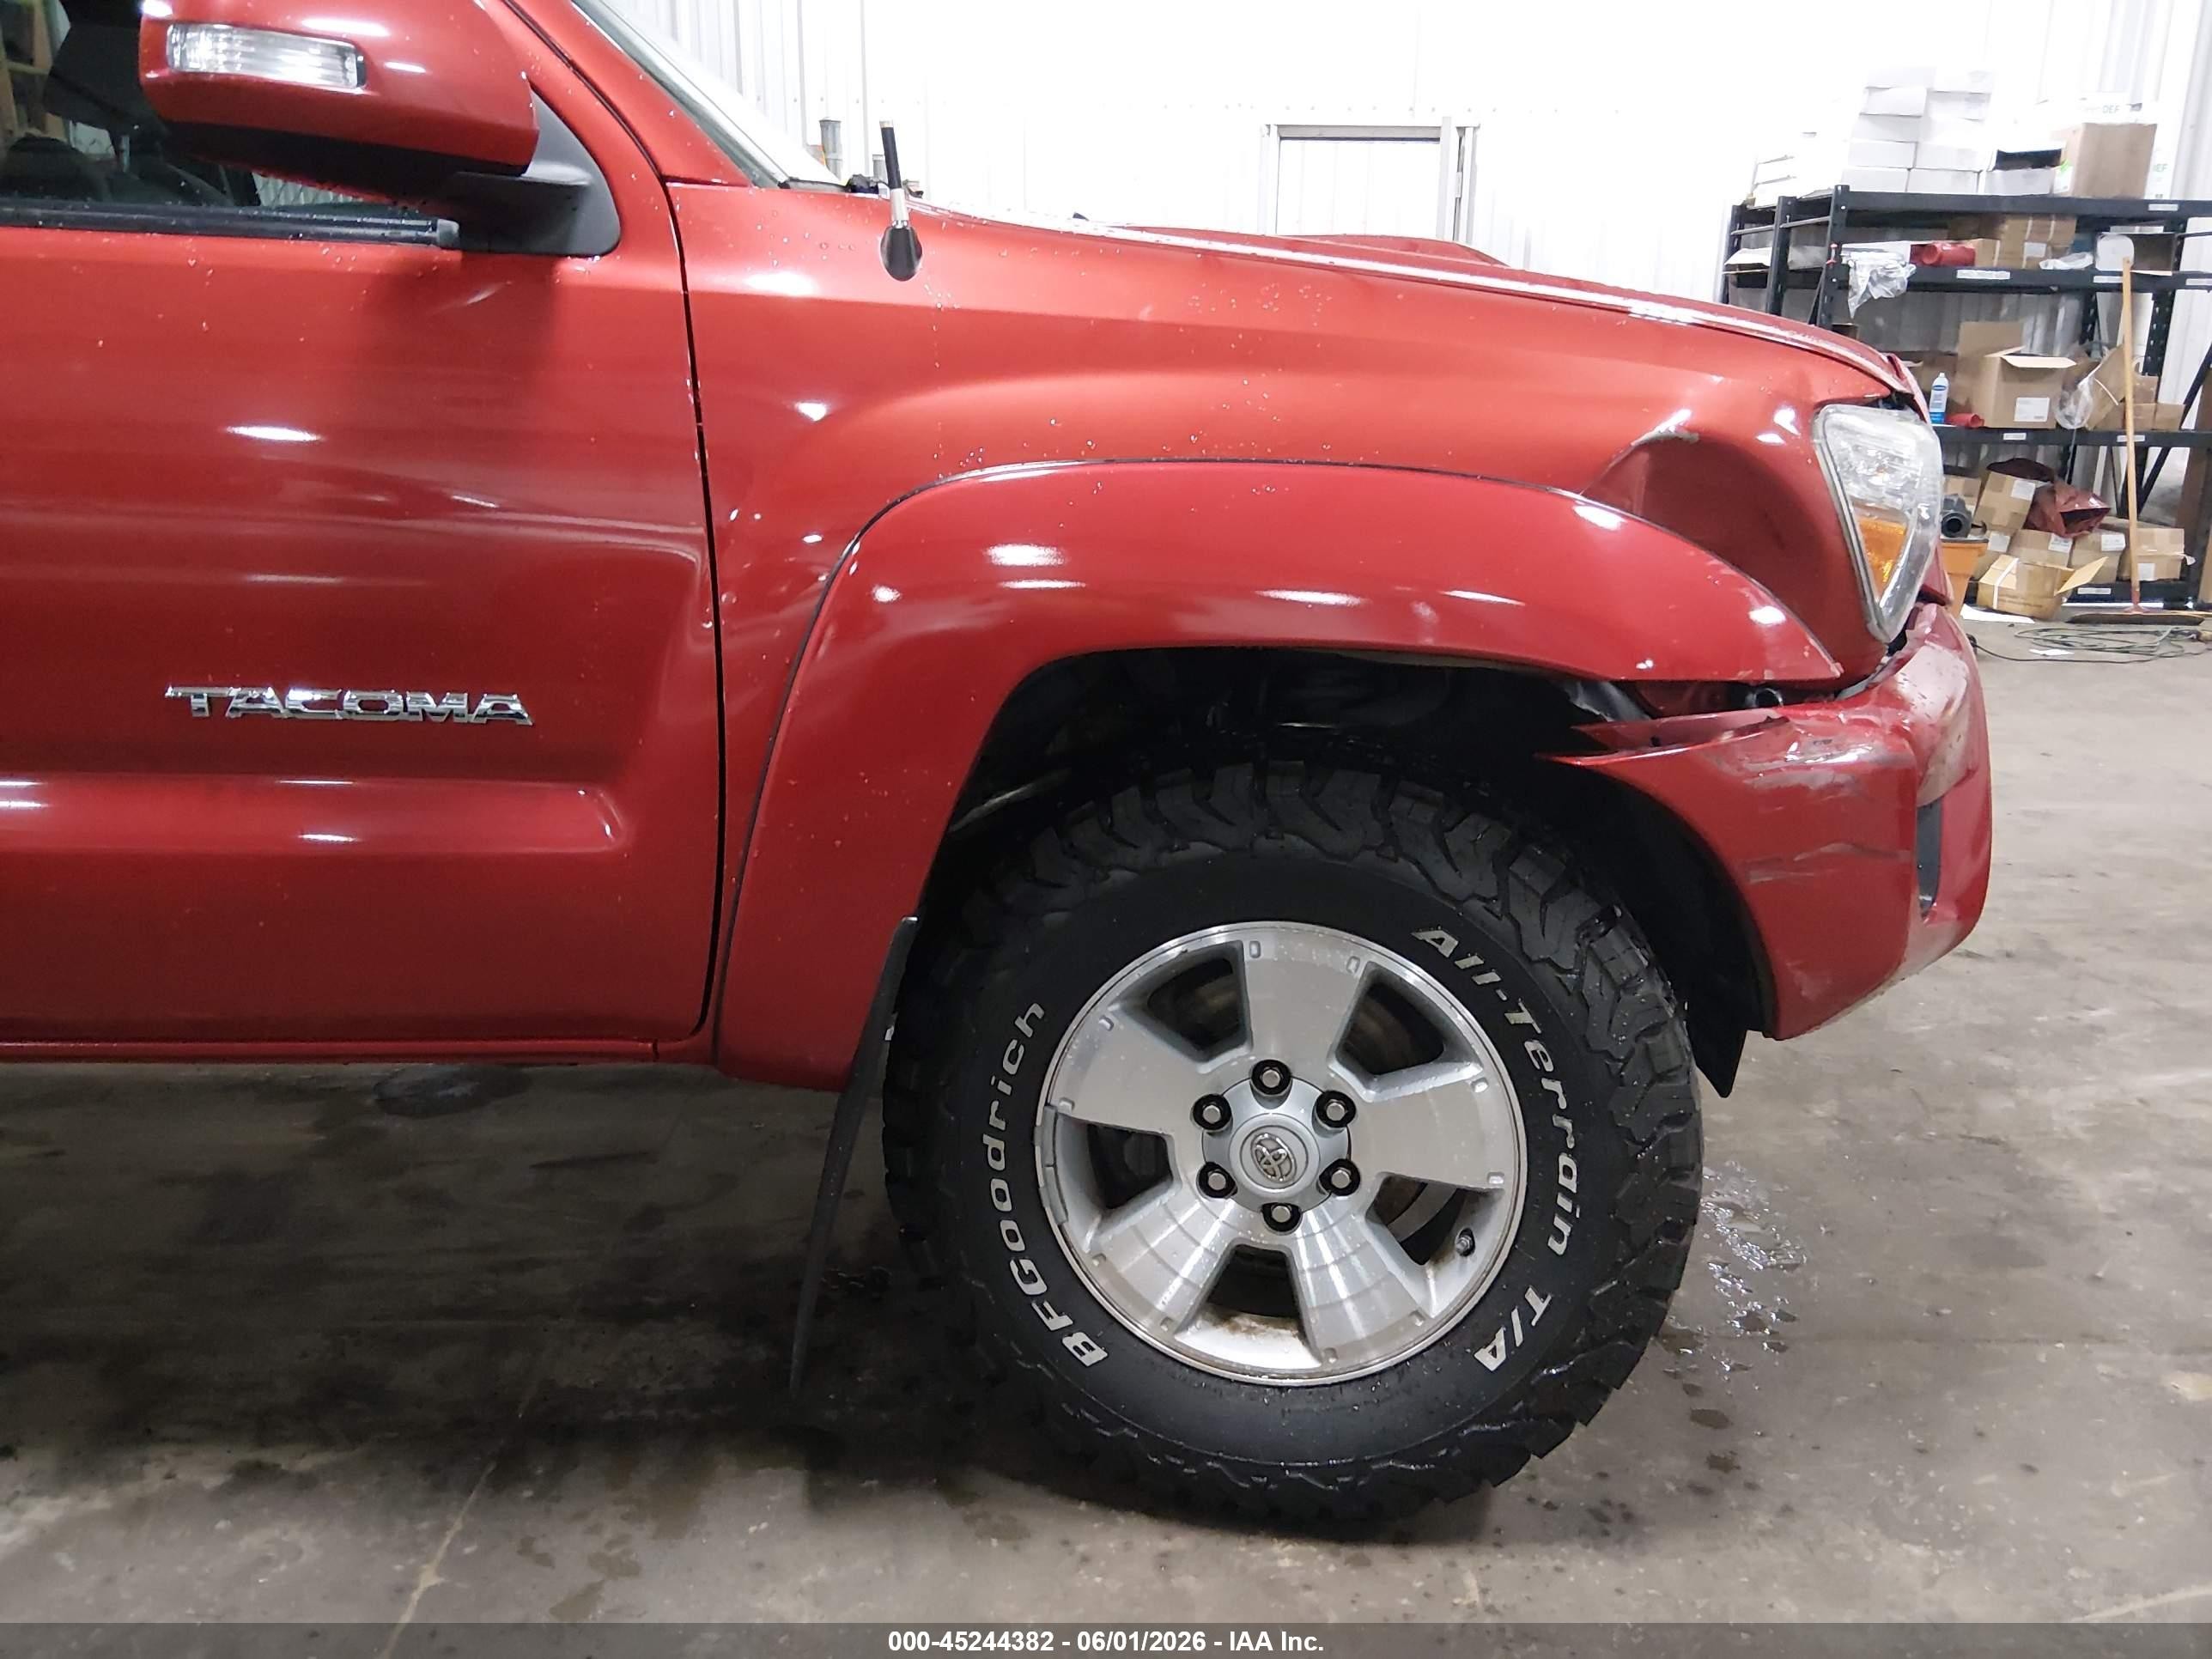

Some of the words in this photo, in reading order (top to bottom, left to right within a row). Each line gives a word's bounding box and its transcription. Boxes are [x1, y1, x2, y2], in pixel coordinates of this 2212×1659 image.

[166, 685, 534, 726] TACOMA
[982, 1002, 1109, 1367] BFGoodrich
[1411, 927, 1581, 1256] All-Terrain
[1474, 1286, 1553, 1372] T/A
